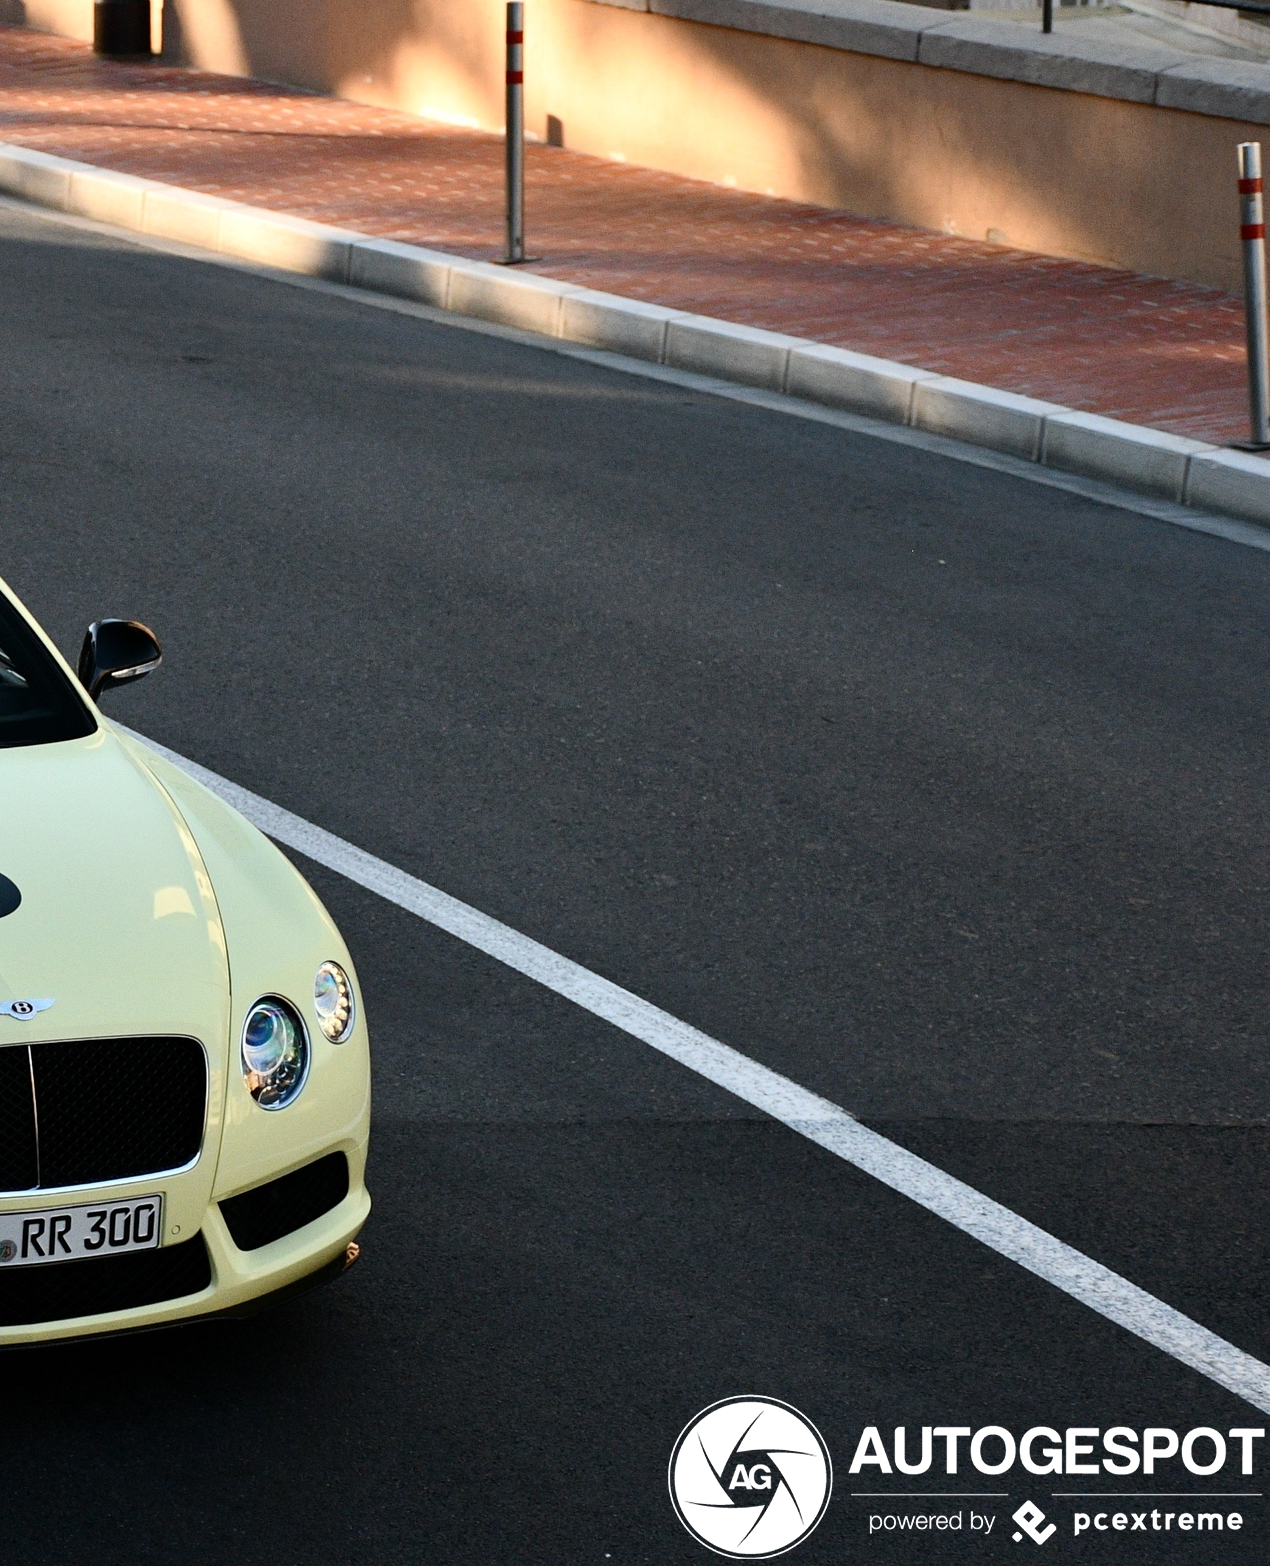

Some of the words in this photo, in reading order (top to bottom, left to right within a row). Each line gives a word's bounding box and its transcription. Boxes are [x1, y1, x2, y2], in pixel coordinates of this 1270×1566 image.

[14, 1002, 31, 1013] B
[21, 1214, 72, 1258] RR
[83, 1203, 156, 1250] 300
